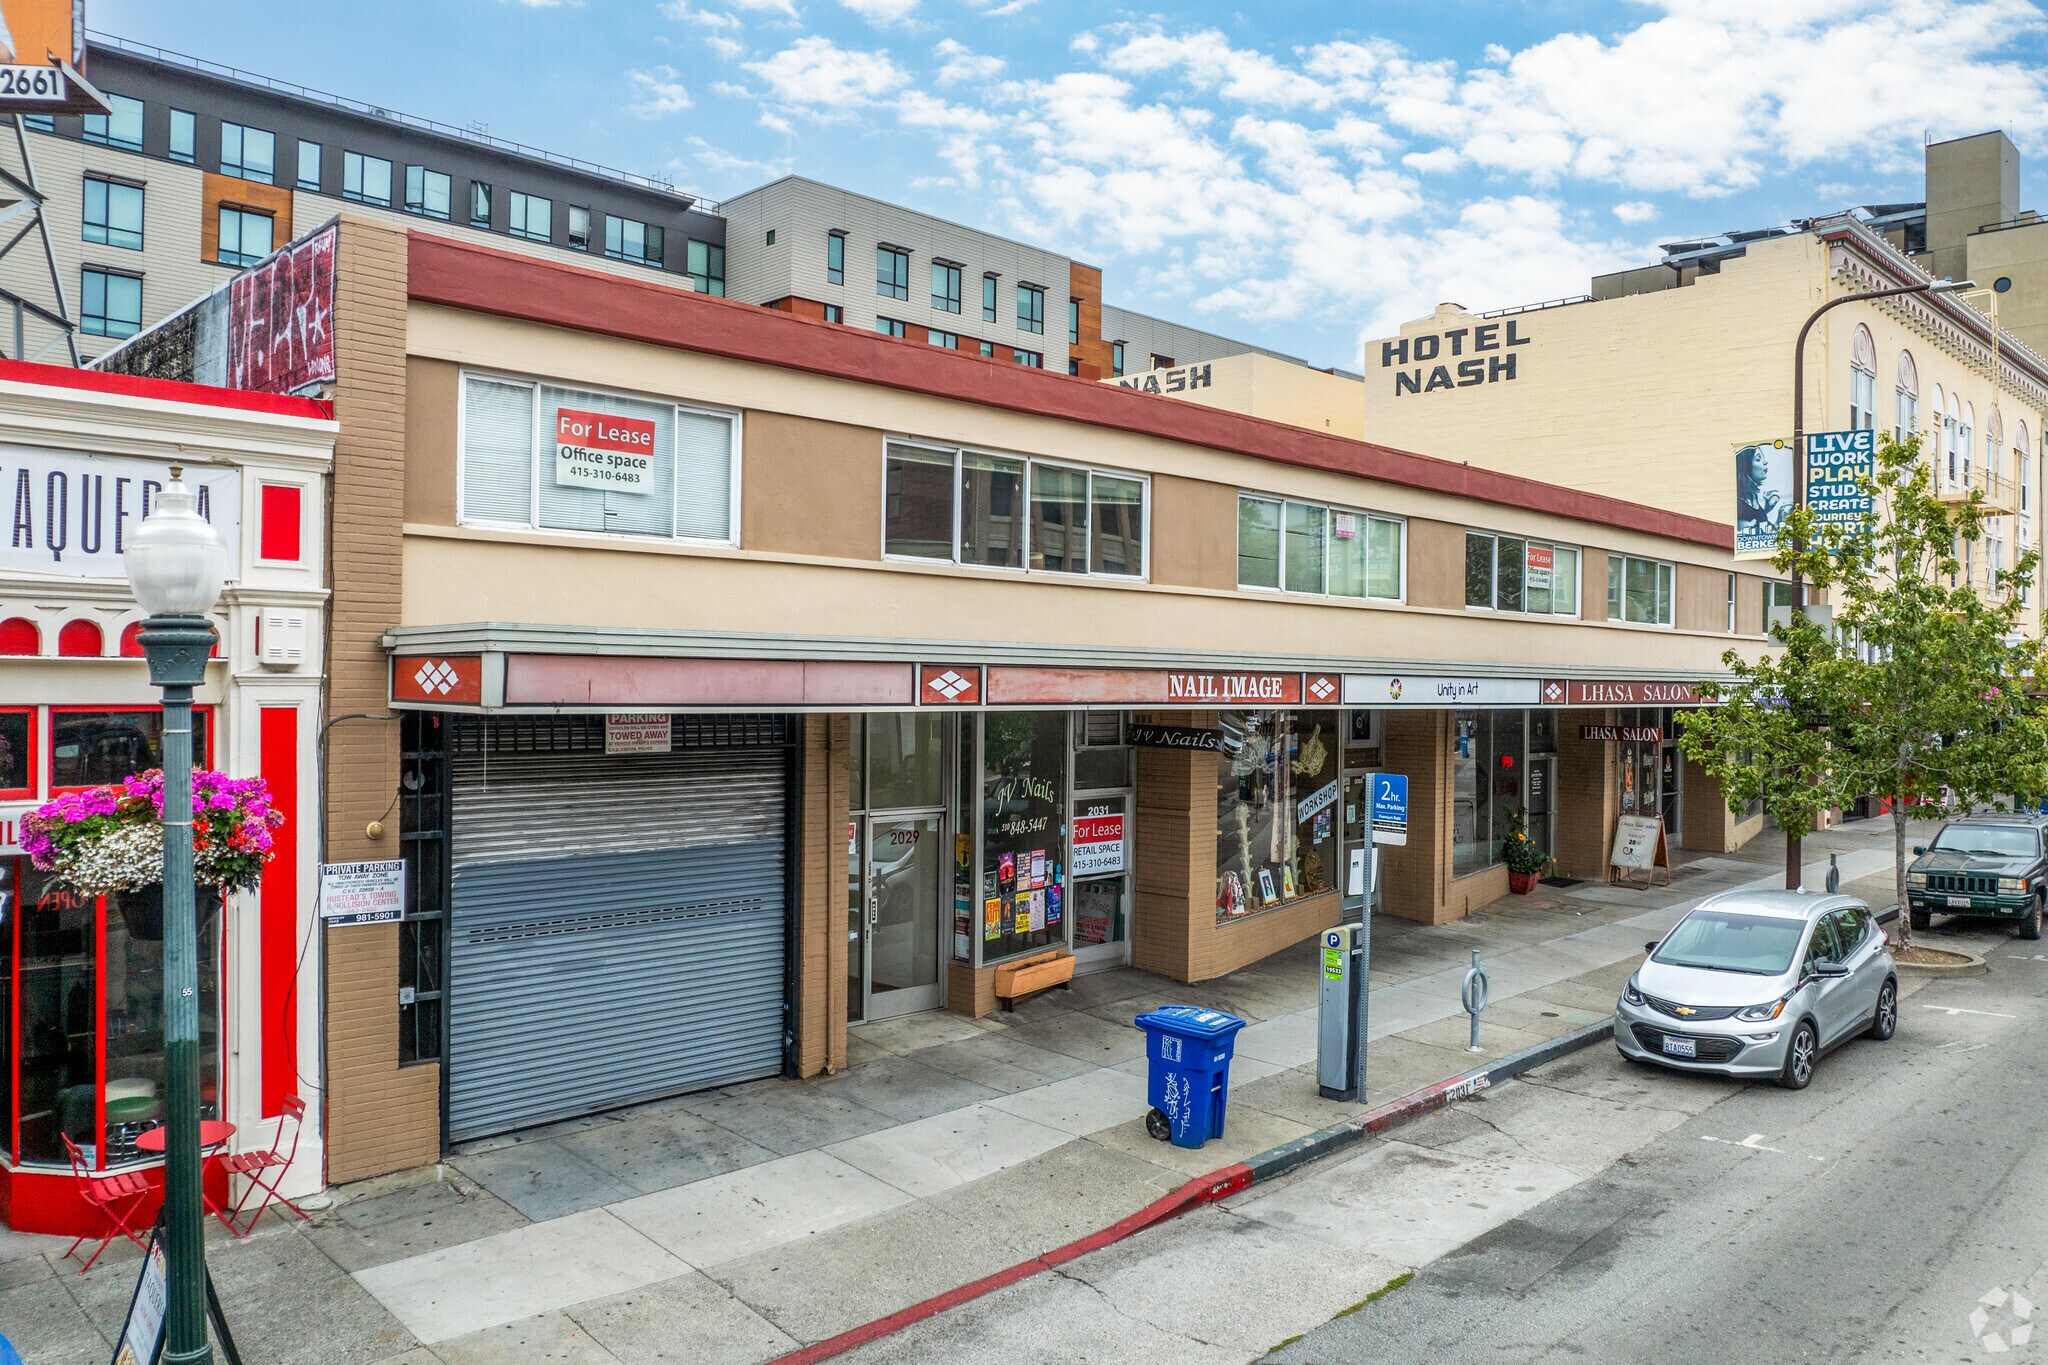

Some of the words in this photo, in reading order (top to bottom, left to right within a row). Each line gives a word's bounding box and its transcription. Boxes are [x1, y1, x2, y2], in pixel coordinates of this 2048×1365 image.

[0, 68, 58, 95] 2661
[1382, 320, 1530, 367] HOTEL
[1395, 353, 1516, 396] NASH
[560, 416, 592, 437] For
[598, 422, 651, 445] Lease
[1810, 432, 1871, 452] LIVE
[561, 446, 603, 463] Office
[606, 455, 647, 469] space
[1810, 451, 1870, 466] WORK
[570, 466, 640, 483] 415-310-6483
[1810, 465, 1870, 483] PLAY
[1808, 498, 1870, 510] CREATE
[0, 468, 211, 562] AQUEA
[1811, 512, 1870, 521] OURNEY
[1169, 675, 1217, 697] NAIL
[1222, 676, 1282, 698] IMAGE
[1437, 682, 1457, 700] Unity
[1458, 682, 1465, 695] in
[1467, 681, 1479, 695] Art
[1582, 684, 1634, 701] LHASA
[1643, 684, 1691, 701] SALON
[611, 713, 666, 723] PARKING
[609, 732, 642, 740] TOWED
[644, 731, 668, 739] AWAY
[1156, 731, 1216, 748] Nails
[1584, 726, 1617, 740] LHASA
[1623, 727, 1659, 741] SALON
[996, 777, 1017, 817] JV
[1021, 776, 1055, 803] Nails
[1298, 785, 1337, 819] WORKSHOP
[1088, 806, 1109, 816] 2031
[1386, 803, 1405, 812] Parking
[1009, 817, 1048, 835] 848-5447
[1073, 824, 1090, 839] For
[1092, 823, 1121, 837] Lease
[890, 830, 920, 845] 2029
[1073, 846, 1097, 856] RETAIL
[1098, 843, 1120, 854] SPACE
[326, 865, 361, 875] PRIVATE
[363, 862, 400, 872] PARKING
[1073, 856, 1121, 870] 415-310-6483
[326, 894, 367, 903] HUSTEAD'S
[369, 891, 397, 899] TOWING
[372, 898, 399, 906] CENTER
[356, 912, 394, 922] 981-5901
[1330, 935, 1338, 945] P
[182, 988, 193, 997] 55
